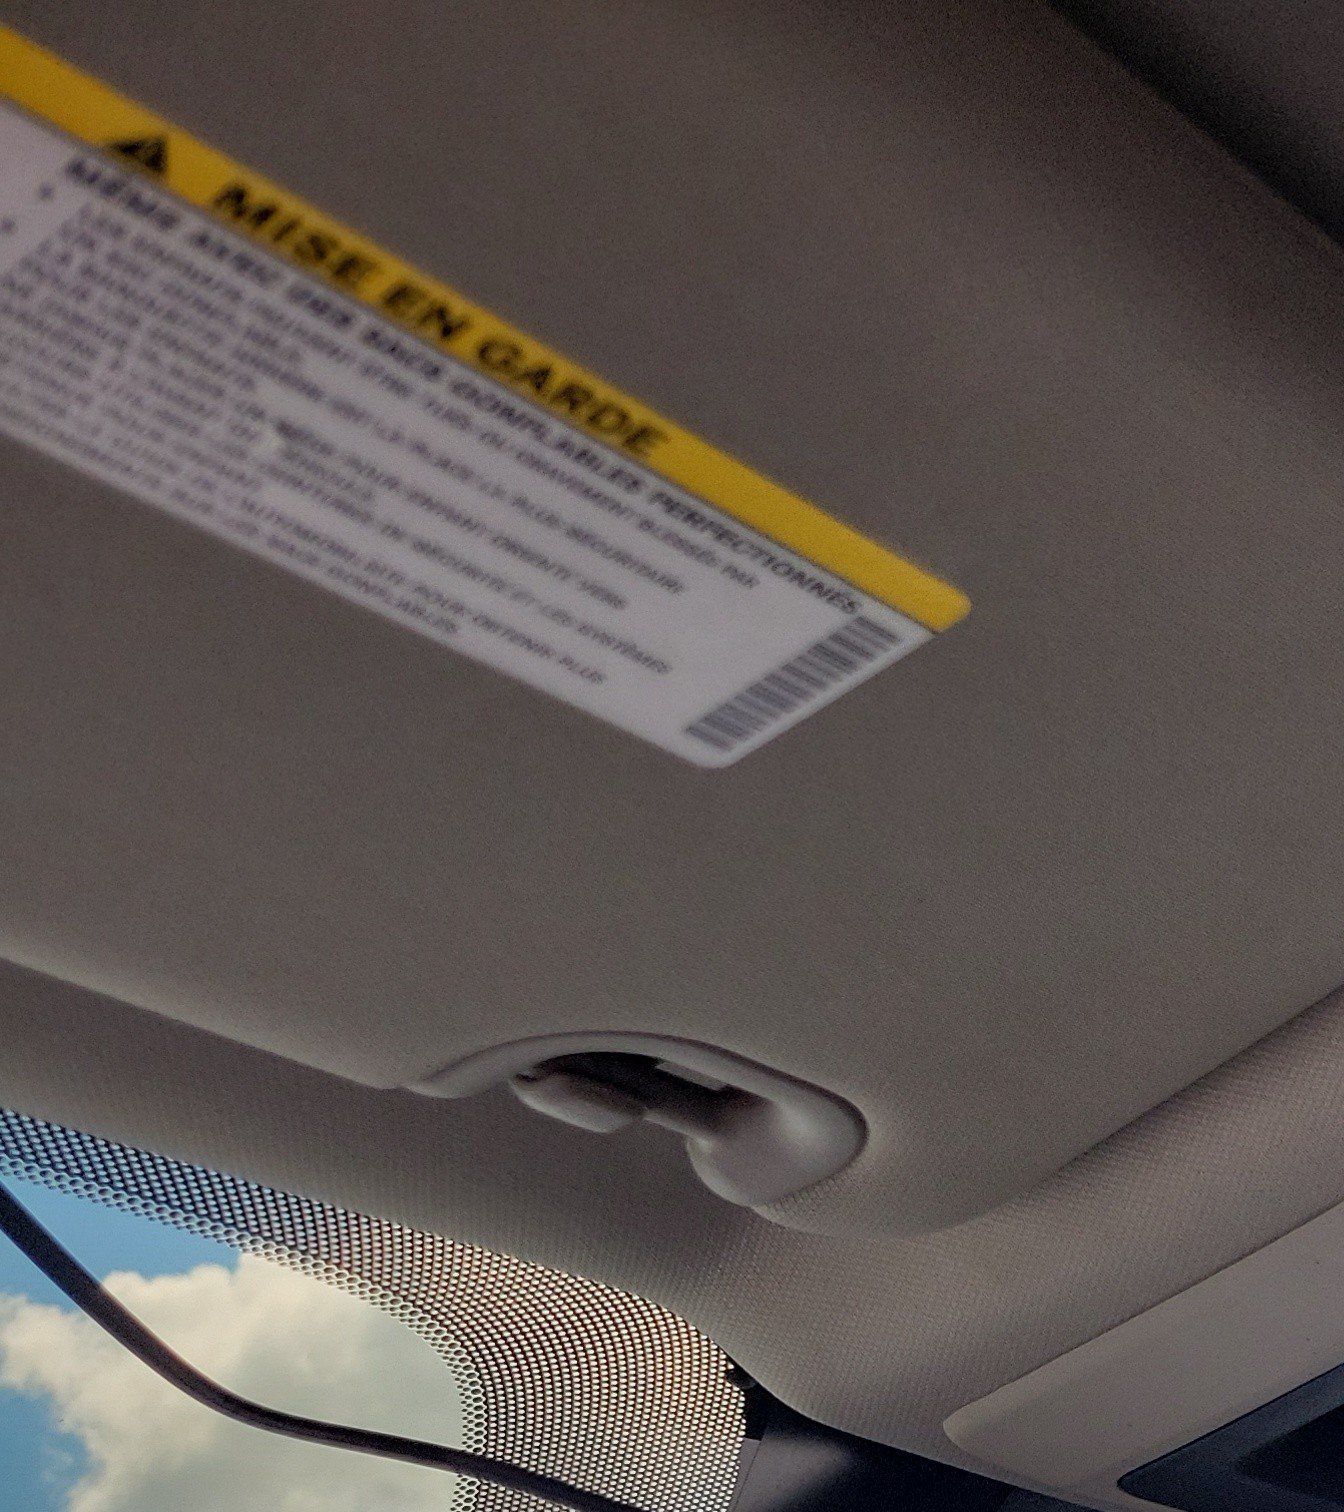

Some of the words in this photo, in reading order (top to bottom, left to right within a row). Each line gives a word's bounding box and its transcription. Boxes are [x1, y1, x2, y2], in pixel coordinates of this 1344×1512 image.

[213, 185, 369, 286] MISE
[381, 284, 467, 342] EN
[475, 339, 660, 454] GARDE
[450, 380, 645, 492] GONFLABLES
[650, 491, 858, 613] PERFECTIONNÉS
